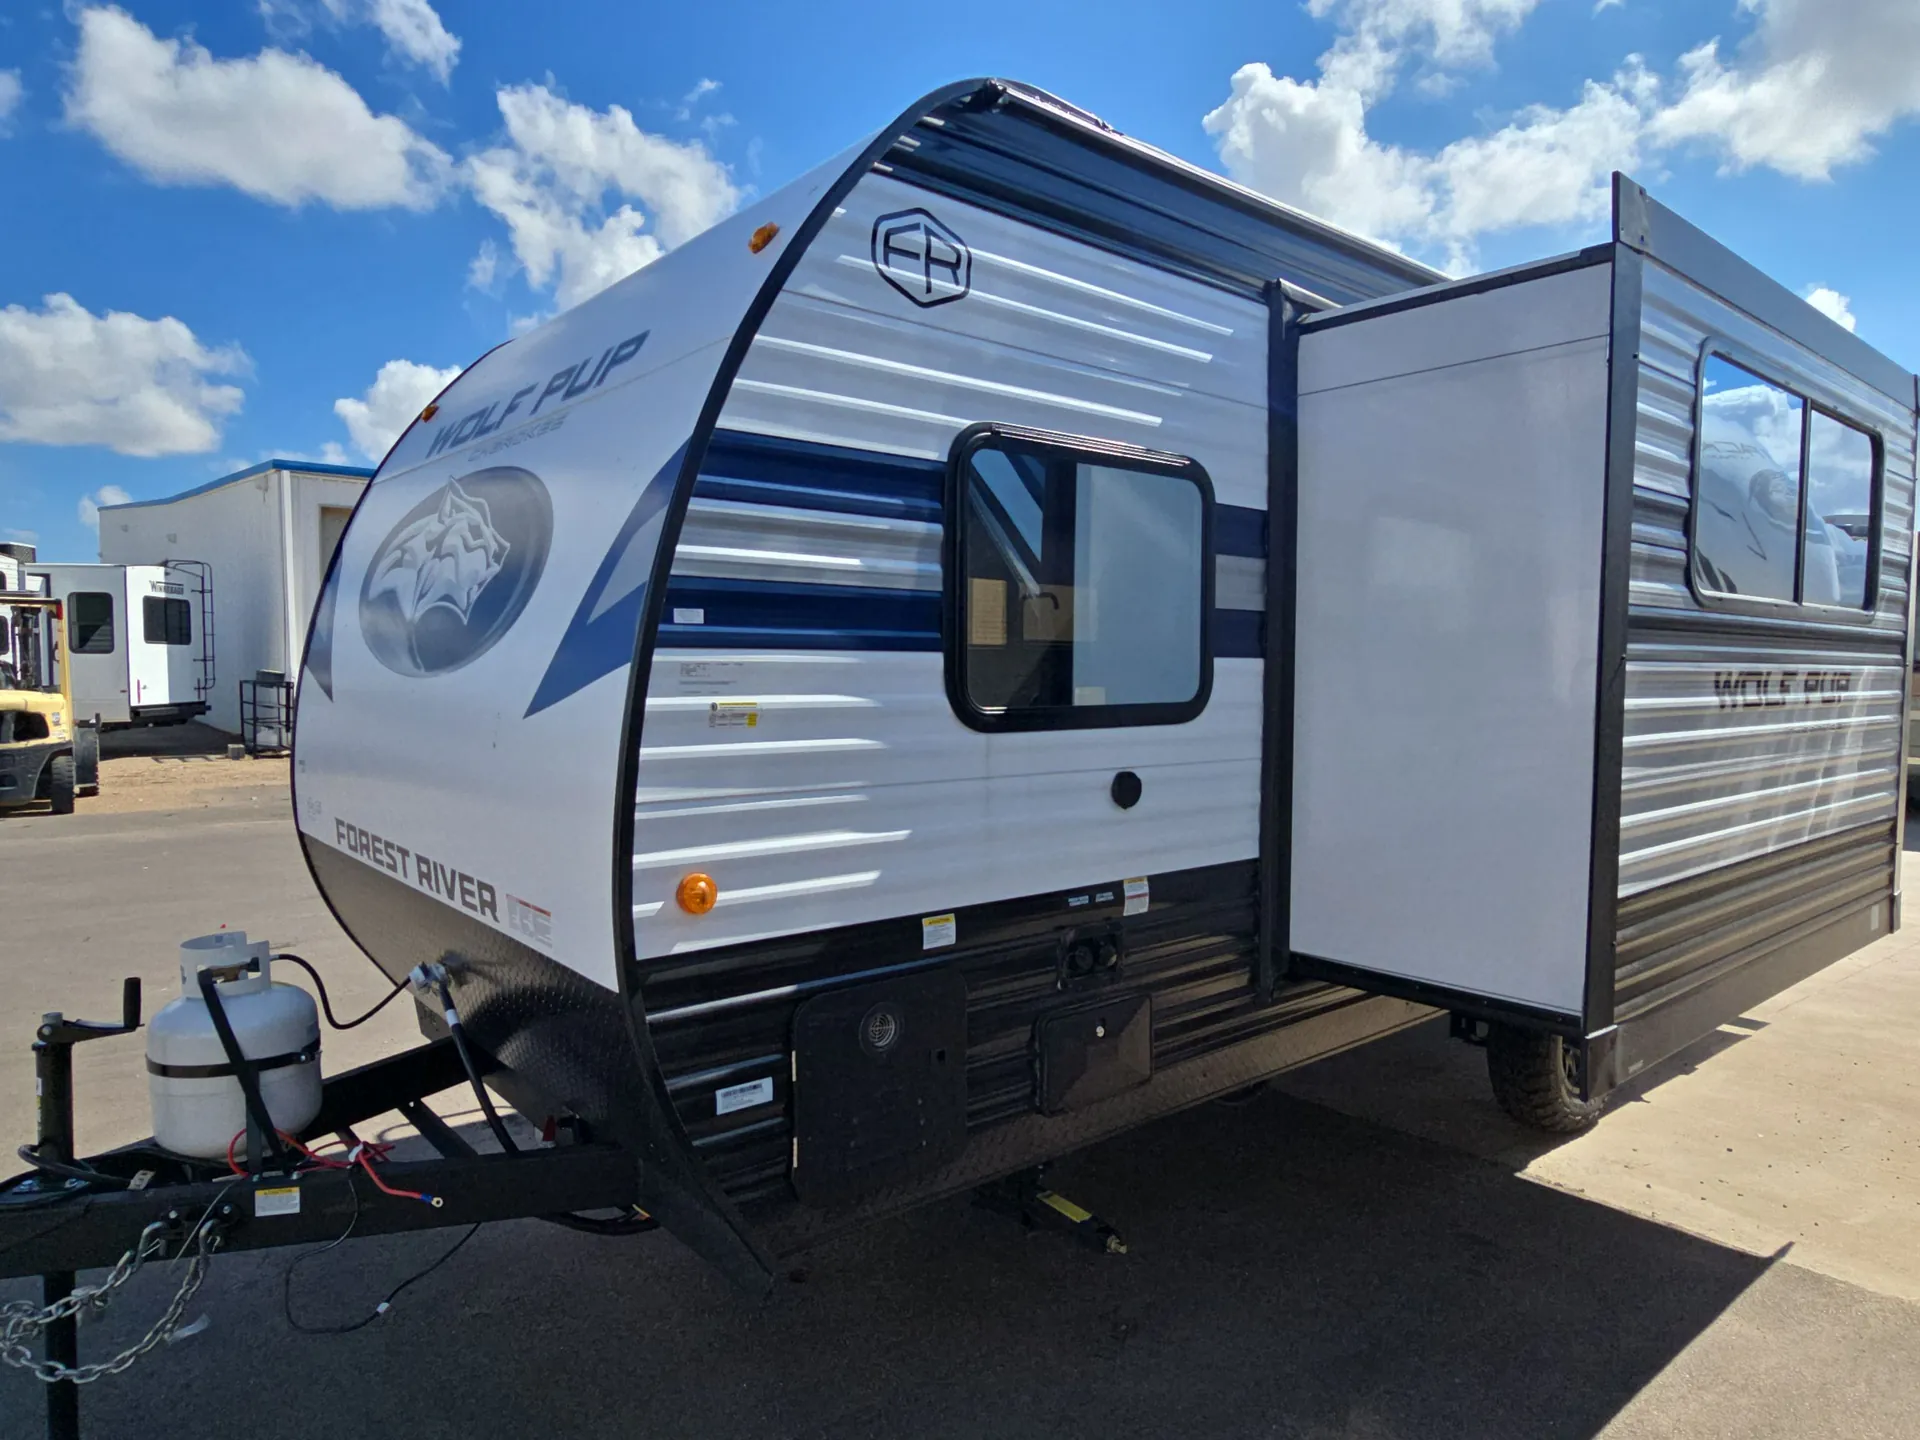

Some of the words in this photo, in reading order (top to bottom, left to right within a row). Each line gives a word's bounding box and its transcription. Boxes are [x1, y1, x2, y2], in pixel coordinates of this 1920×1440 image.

[426, 382, 538, 458] WOLF
[529, 329, 650, 415] PUP
[1714, 671, 1797, 709] WOLF
[1804, 671, 1851, 704] PUP
[335, 817, 410, 879] FOREST
[415, 853, 500, 923] RIVER
